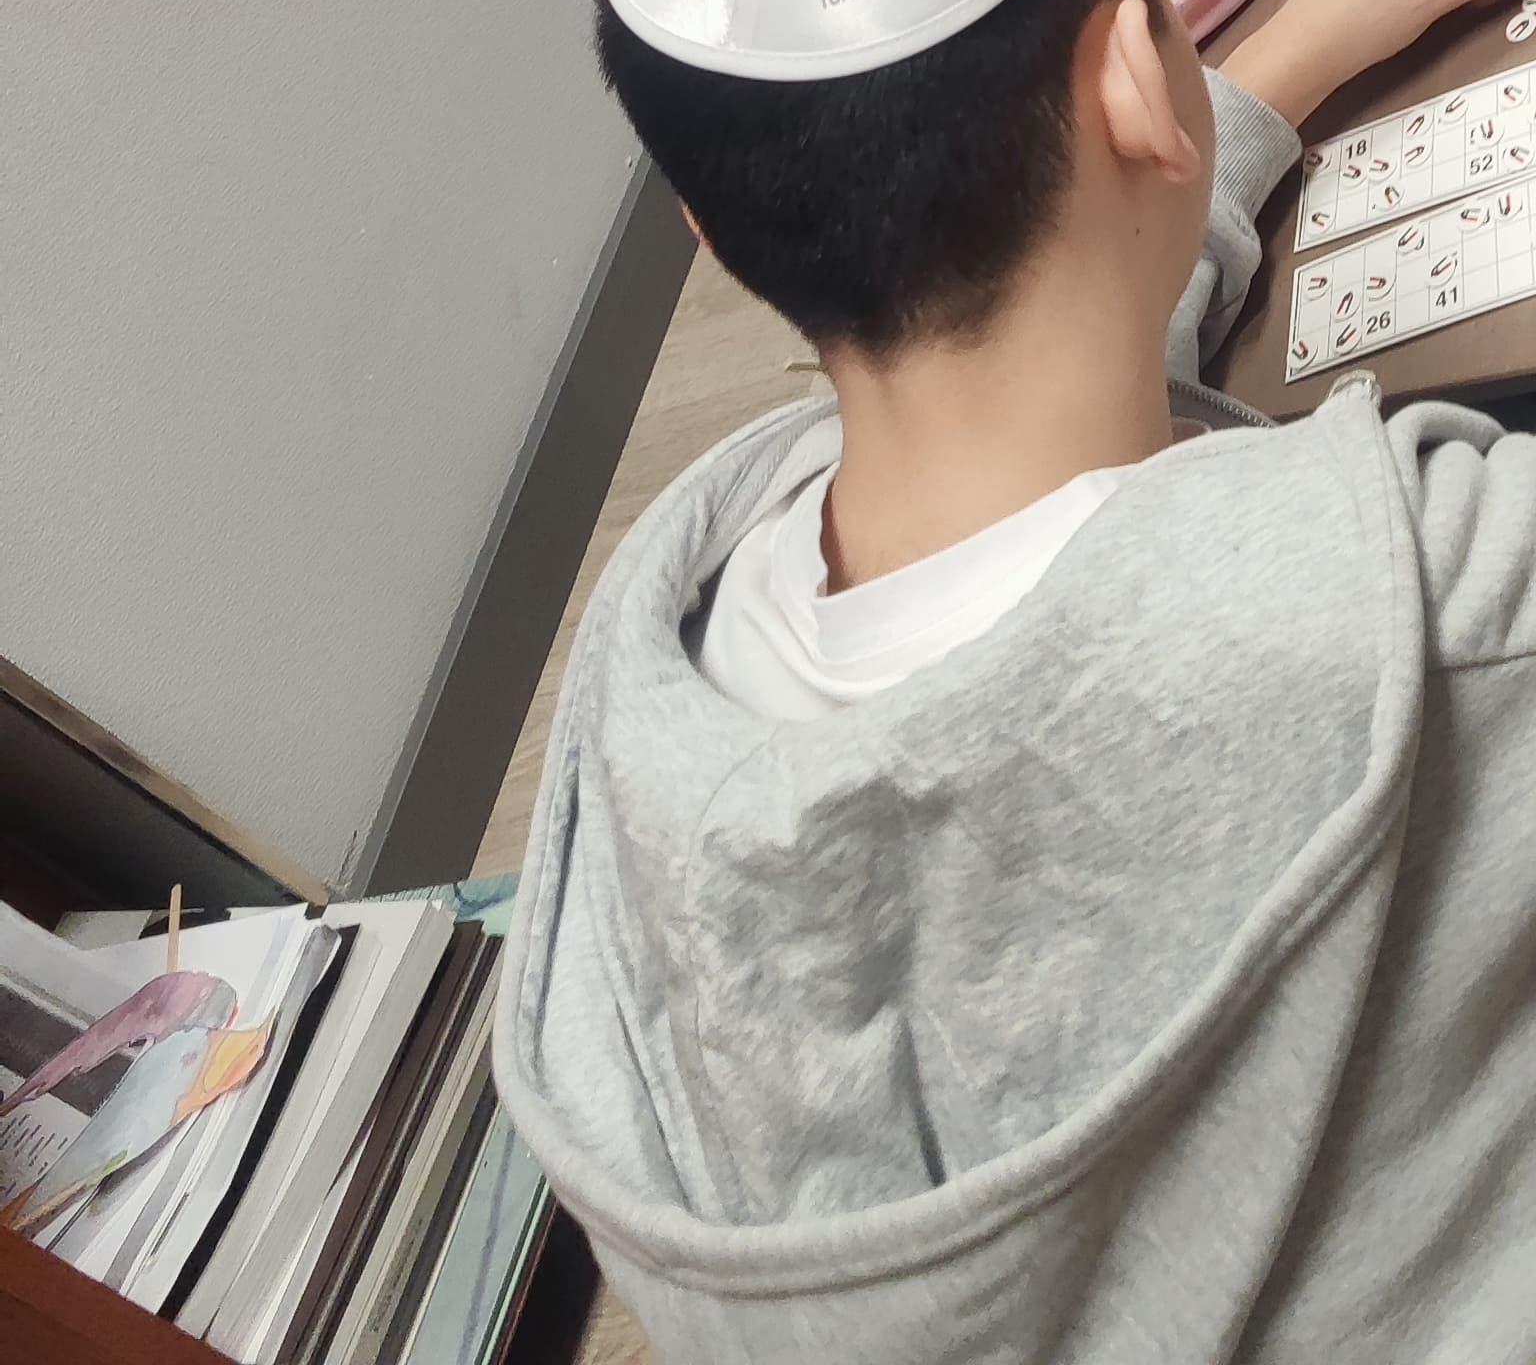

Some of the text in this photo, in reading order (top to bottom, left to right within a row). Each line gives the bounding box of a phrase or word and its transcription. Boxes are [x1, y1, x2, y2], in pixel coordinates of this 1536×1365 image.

[1345, 139, 1368, 160] 18
[1469, 155, 1494, 176] 52
[1366, 286, 1461, 334] 26 41
